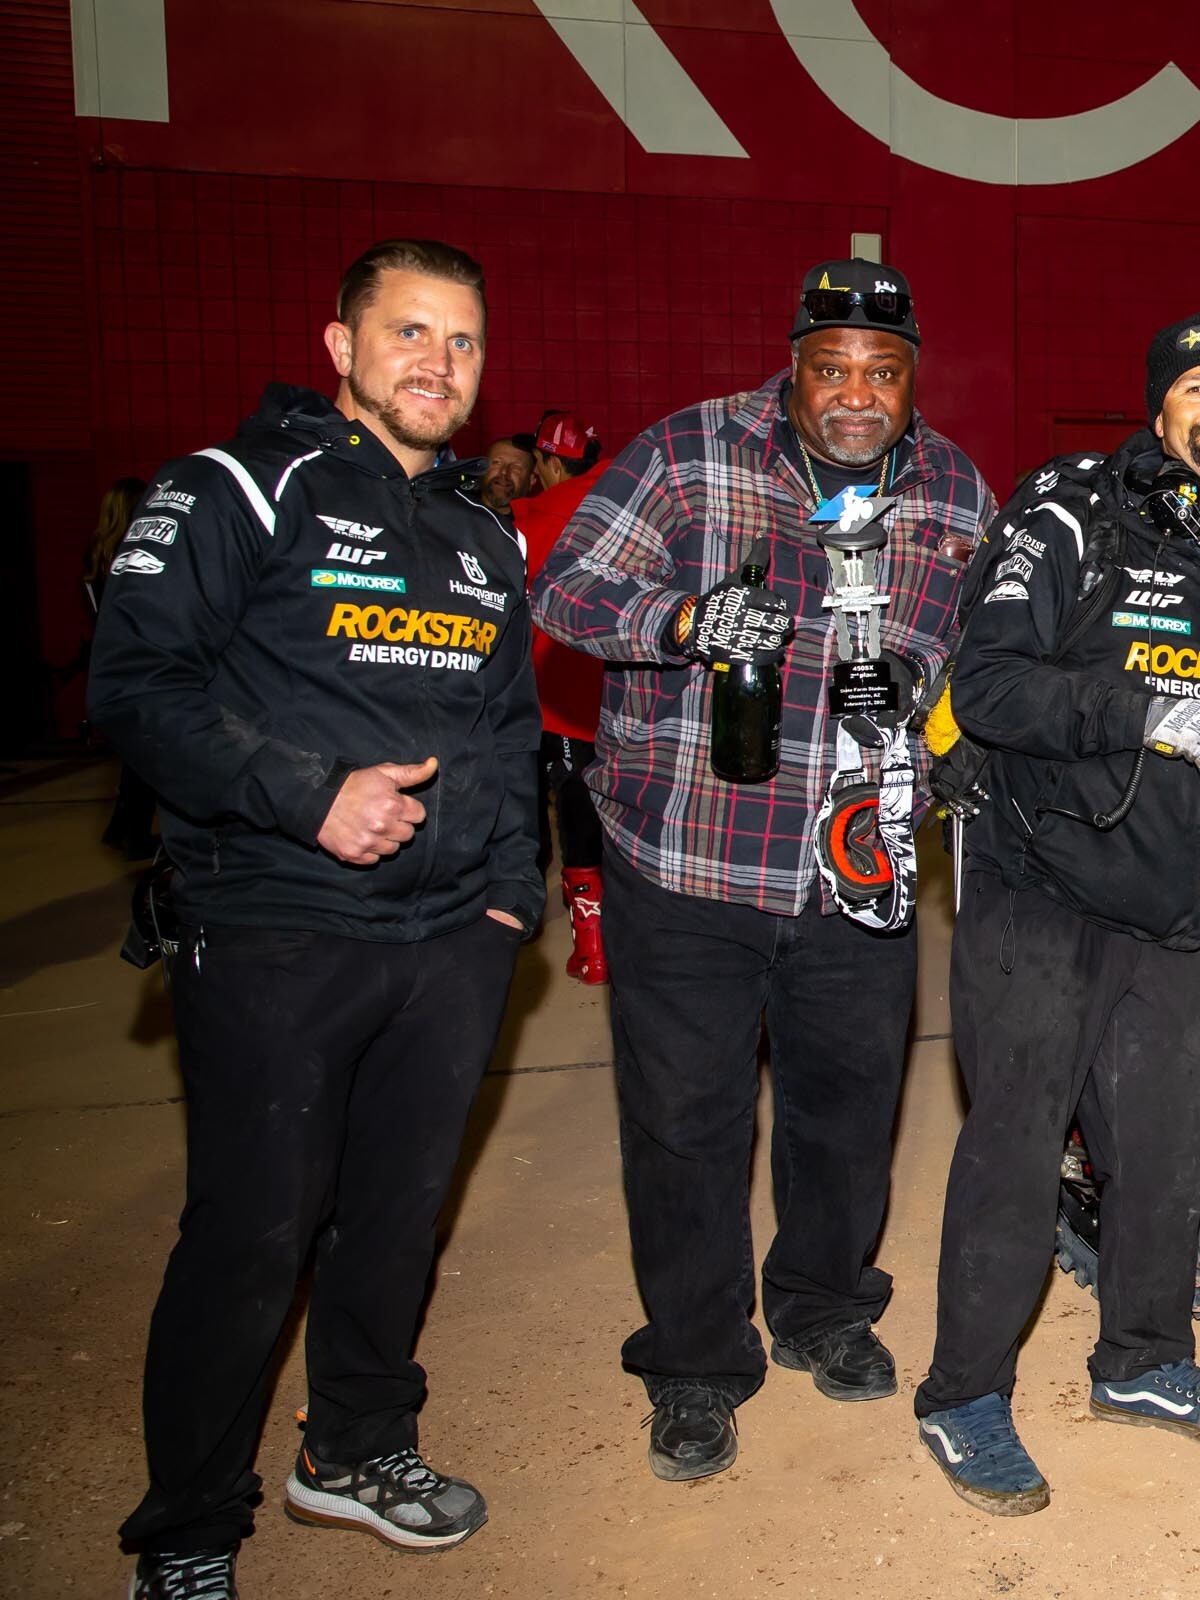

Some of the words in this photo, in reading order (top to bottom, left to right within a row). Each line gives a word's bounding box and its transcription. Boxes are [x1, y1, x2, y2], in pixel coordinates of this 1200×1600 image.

[326, 543, 387, 565] WP
[337, 573, 402, 591] MOTOREX
[450, 580, 507, 605] Husqvarna
[1125, 591, 1184, 608] WP
[326, 603, 497, 655] ROCKSTAR
[1132, 616, 1189, 633] MOTOREX
[349, 643, 430, 667] ENERGY
